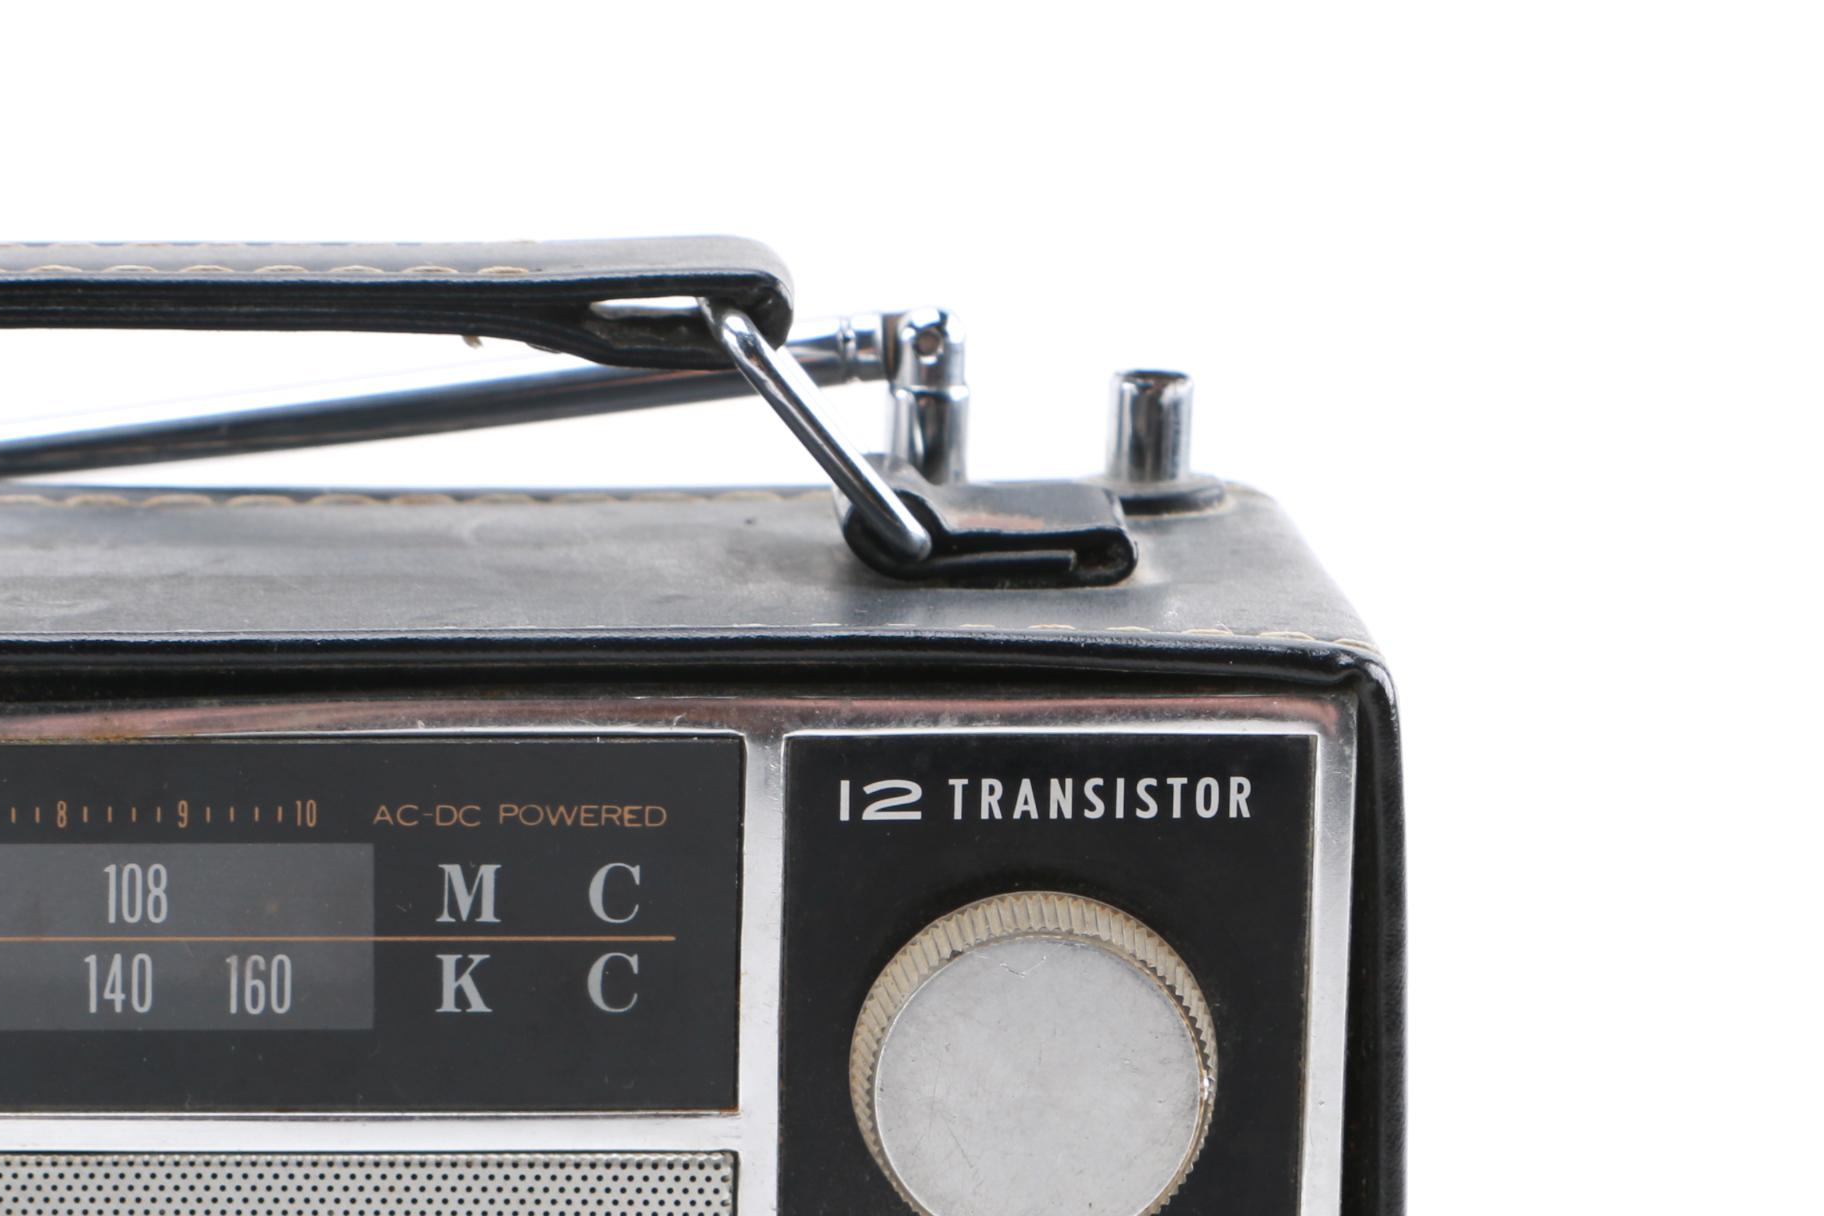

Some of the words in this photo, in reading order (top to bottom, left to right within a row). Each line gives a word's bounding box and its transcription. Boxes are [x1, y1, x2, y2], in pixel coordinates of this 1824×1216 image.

[56, 800, 67, 828] 8
[177, 799, 189, 828] 9
[295, 799, 317, 828] 10
[374, 805, 480, 827] AC-DC
[500, 804, 667, 827] POWERED
[840, 780, 922, 821] 12
[949, 777, 1251, 819] TRANSISTOR
[104, 864, 167, 923] 108
[84, 953, 152, 1013] 140
[226, 954, 291, 1014] 160
